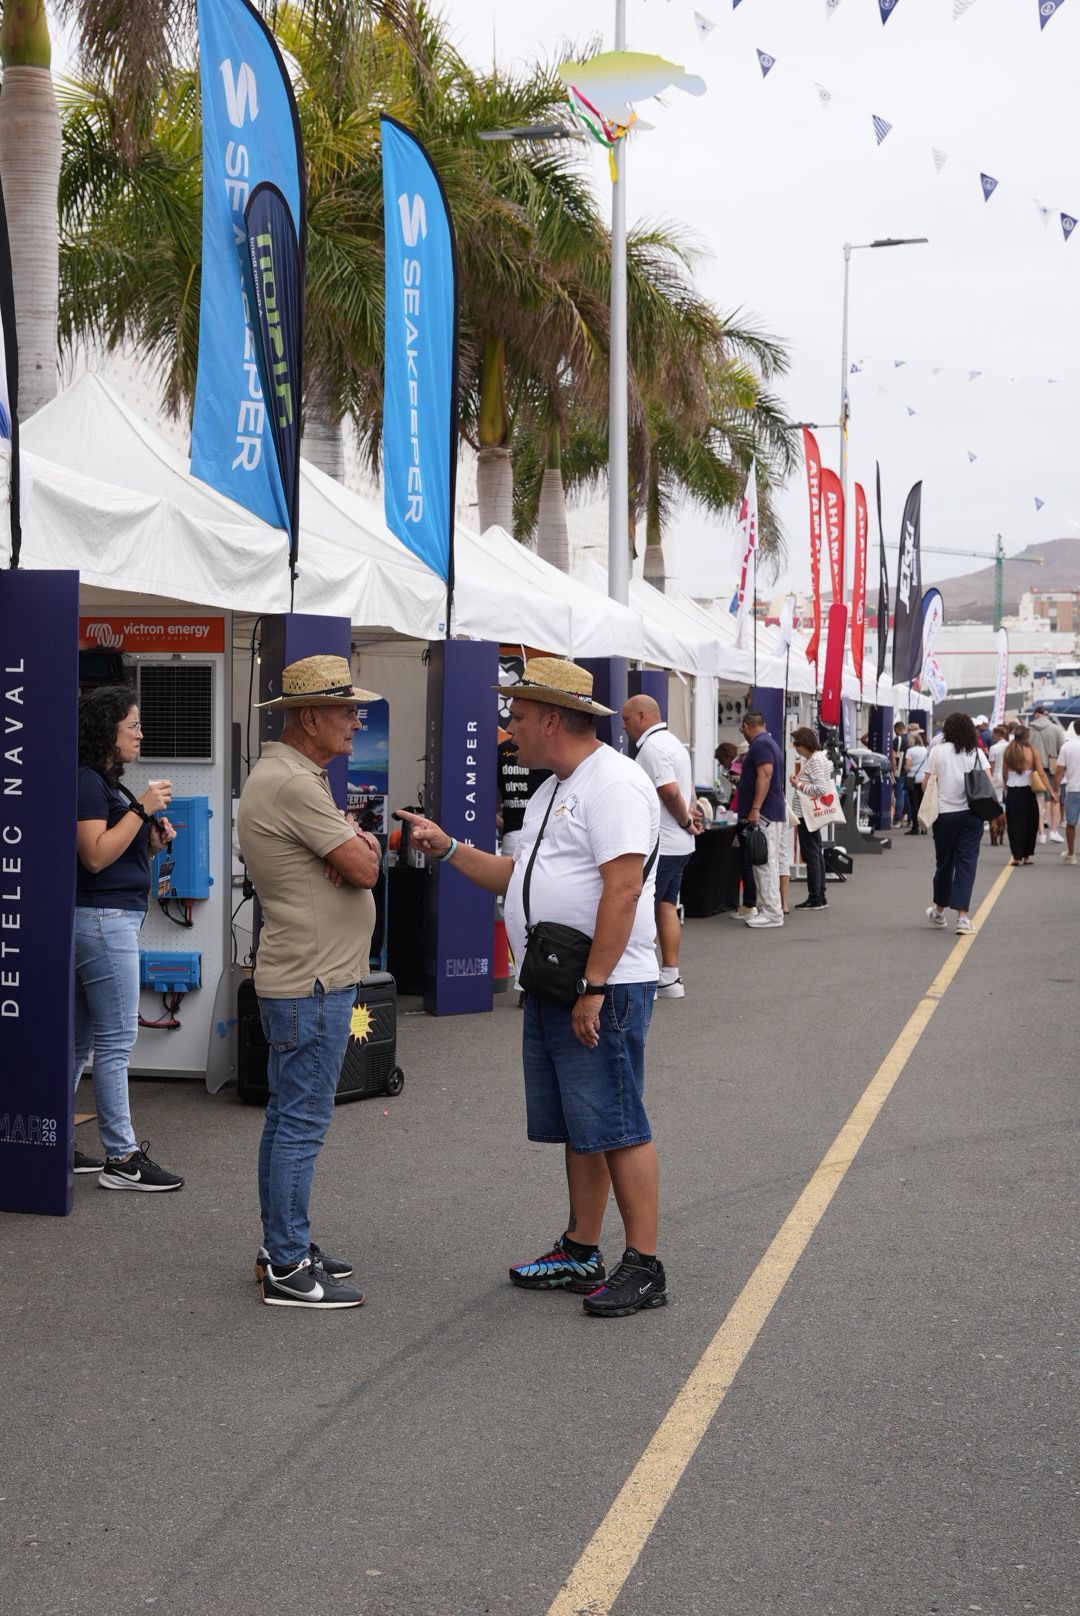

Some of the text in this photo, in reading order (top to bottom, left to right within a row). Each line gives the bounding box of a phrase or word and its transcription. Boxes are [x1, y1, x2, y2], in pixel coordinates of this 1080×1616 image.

[402, 258, 424, 523] SEAKEEPER
[123, 623, 210, 638] victron energy
[464, 720, 478, 822] CAMPER
[505, 782, 528, 792] otros
[1, 658, 25, 1018] DETELEC NAVAL
[42, 1118, 57, 1130] 20
[42, 1130, 57, 1142] 26
